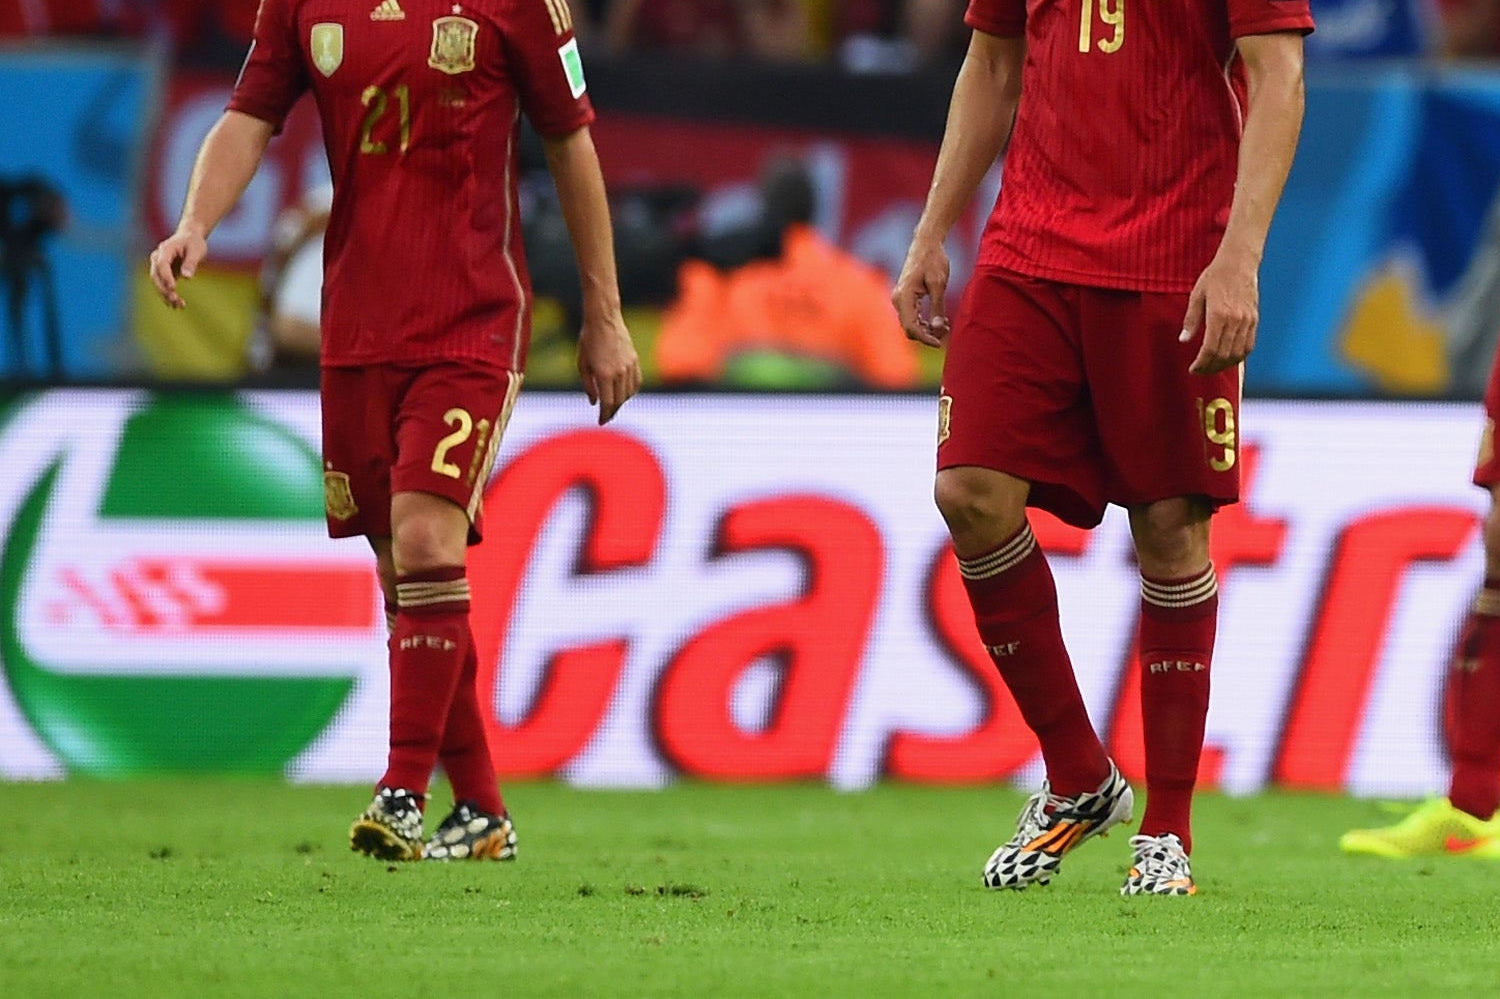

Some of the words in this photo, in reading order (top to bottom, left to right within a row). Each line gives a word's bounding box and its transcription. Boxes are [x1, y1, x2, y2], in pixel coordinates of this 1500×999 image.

[360, 84, 410, 155] 21
[431, 408, 490, 487] 21
[1196, 397, 1236, 472] 9
[1150, 660, 1206, 674] RFEF
